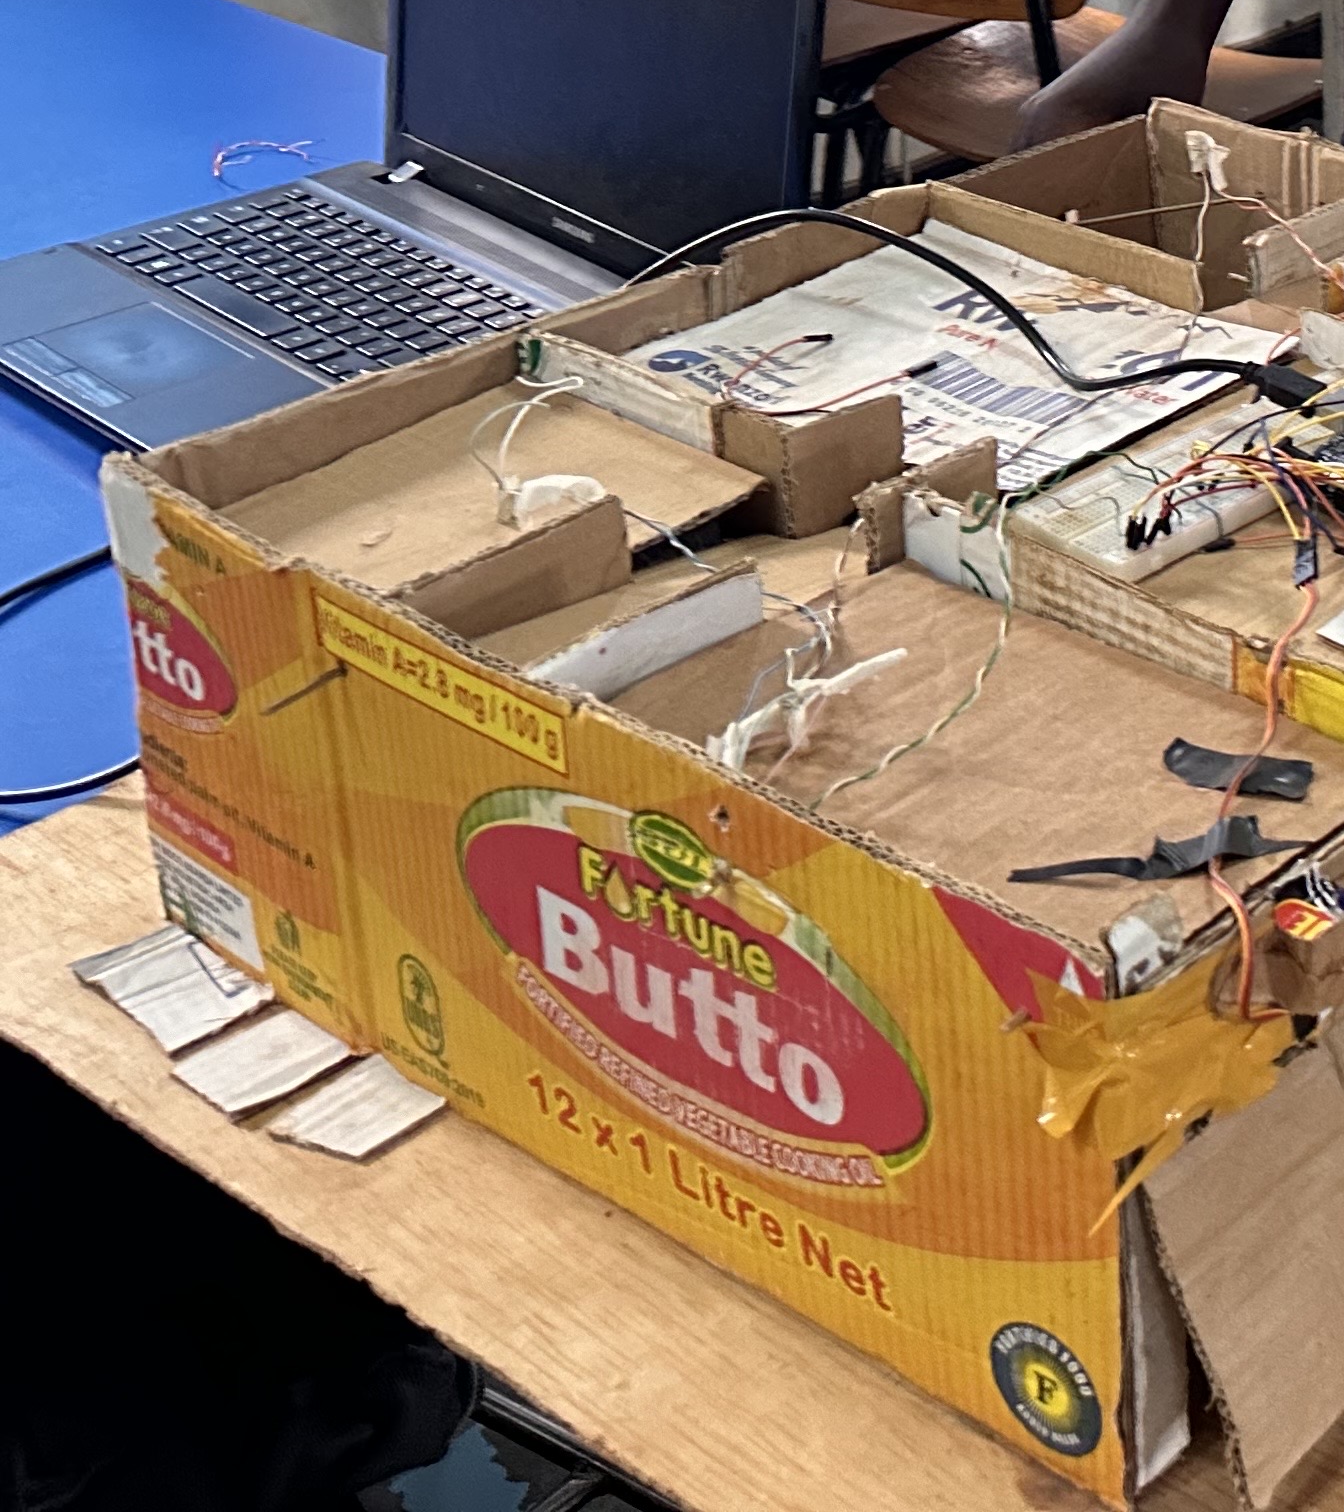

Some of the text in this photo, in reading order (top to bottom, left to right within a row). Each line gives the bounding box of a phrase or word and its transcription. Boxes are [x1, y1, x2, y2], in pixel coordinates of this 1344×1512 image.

[134, 619, 206, 702] tto
[577, 842, 778, 990] Fortune
[535, 884, 846, 1126] Butto
[527, 1073, 582, 1135] 12
[591, 1116, 619, 1157] x
[629, 1131, 653, 1175] 1
[668, 1148, 785, 1248] Litre
[797, 1221, 892, 1312] Net
[1033, 1369, 1058, 1405] F
